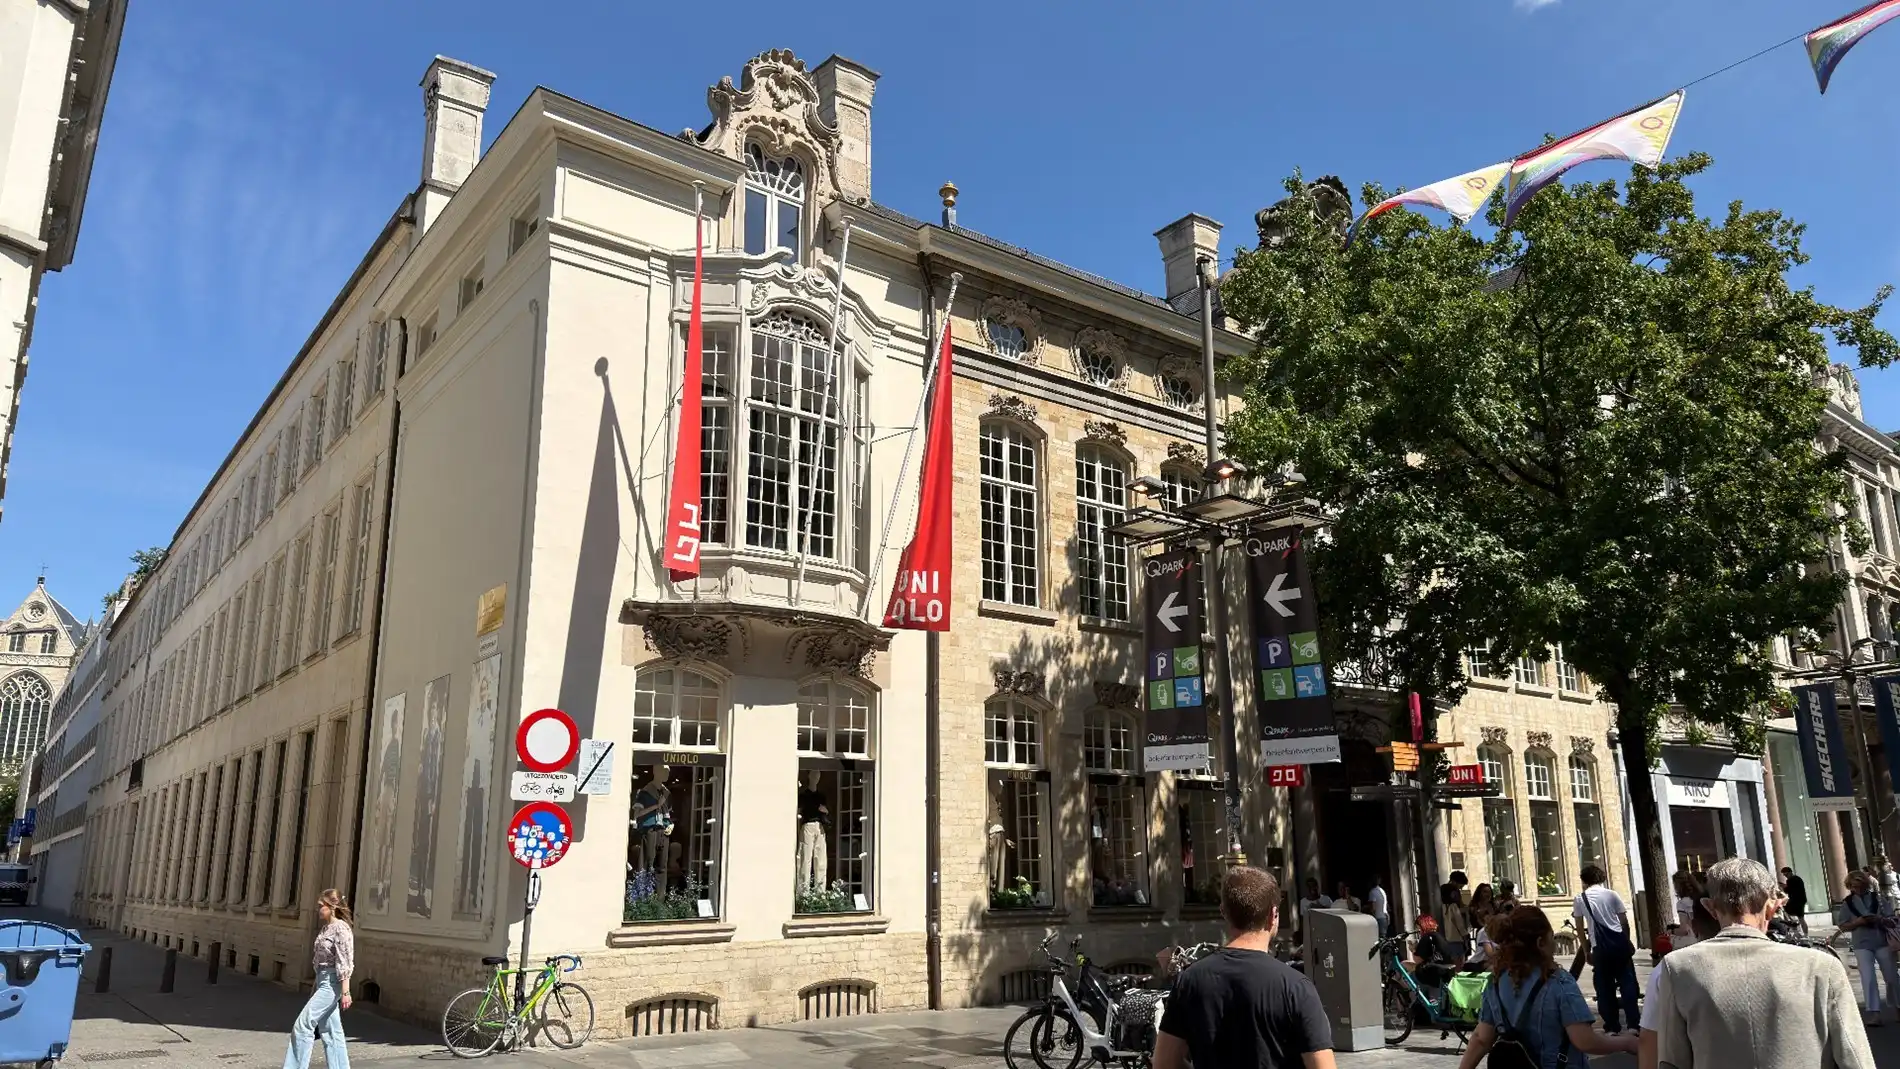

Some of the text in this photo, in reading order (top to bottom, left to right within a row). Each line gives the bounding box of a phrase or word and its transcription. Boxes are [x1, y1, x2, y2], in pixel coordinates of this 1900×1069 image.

[898, 570, 939, 593] UNI
[892, 598, 943, 625] QLO
[1807, 690, 1836, 793] SKECHERS
[663, 752, 699, 764] UNIQLO
[1007, 771, 1032, 780] UNIQLO
[1452, 768, 1474, 781] UNI
[1684, 781, 1711, 798] KIKO
